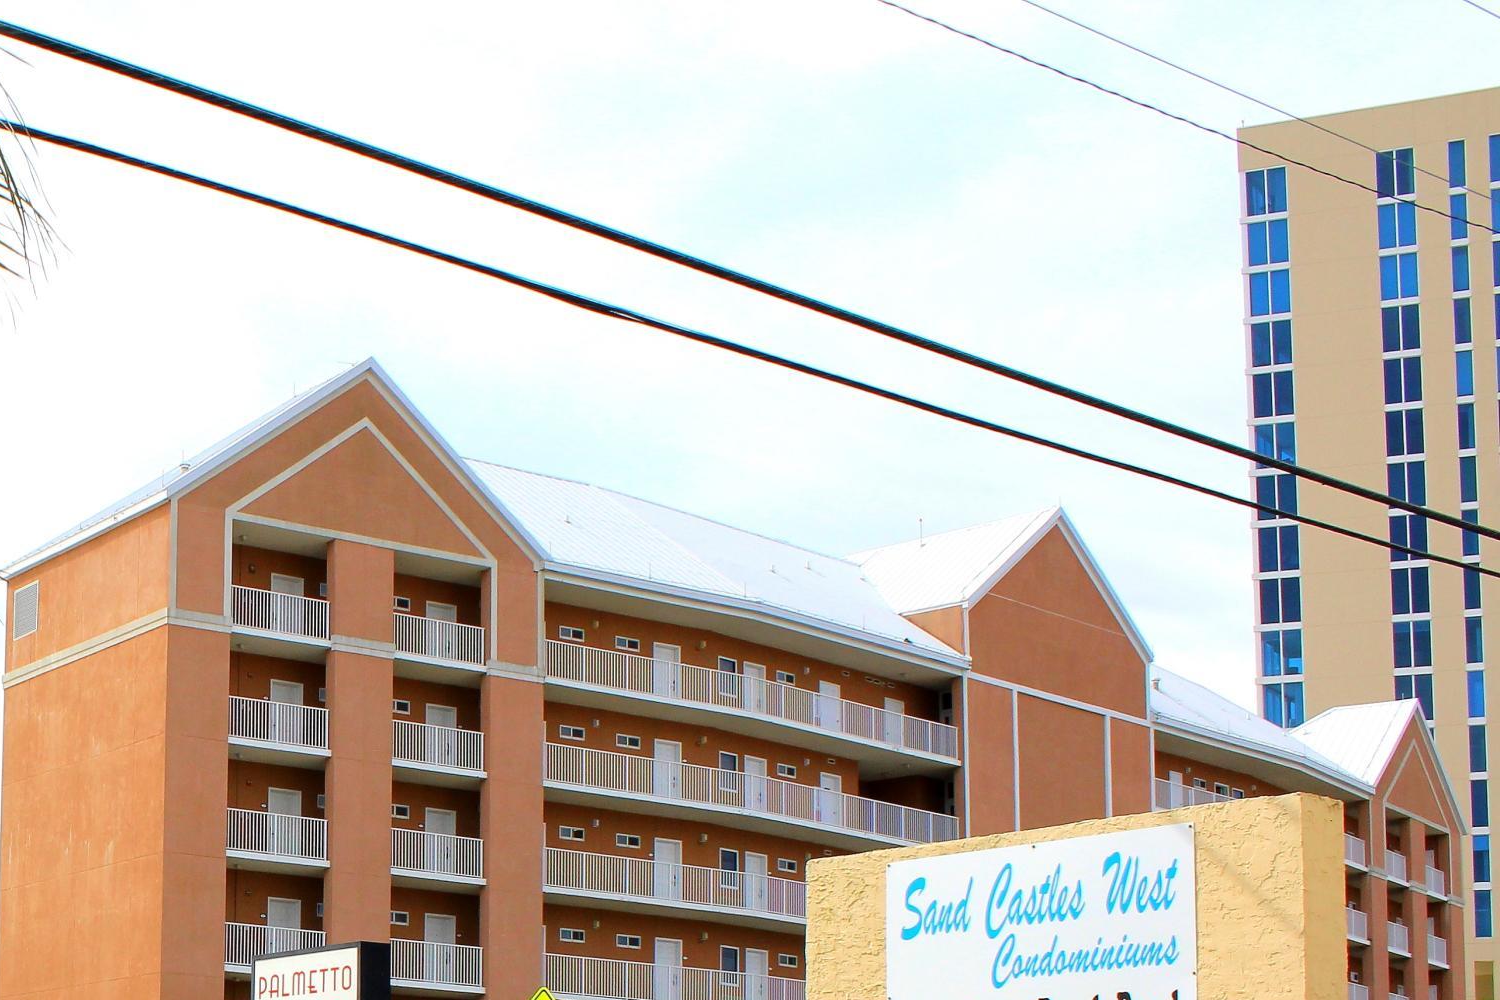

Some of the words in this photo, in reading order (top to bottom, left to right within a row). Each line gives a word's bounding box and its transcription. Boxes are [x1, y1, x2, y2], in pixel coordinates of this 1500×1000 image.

[901, 876, 973, 940] Sand
[985, 862, 1086, 939] Castles
[1102, 851, 1178, 915] West
[258, 965, 352, 1000] PALMETTO
[991, 933, 1180, 989] Condominiums
